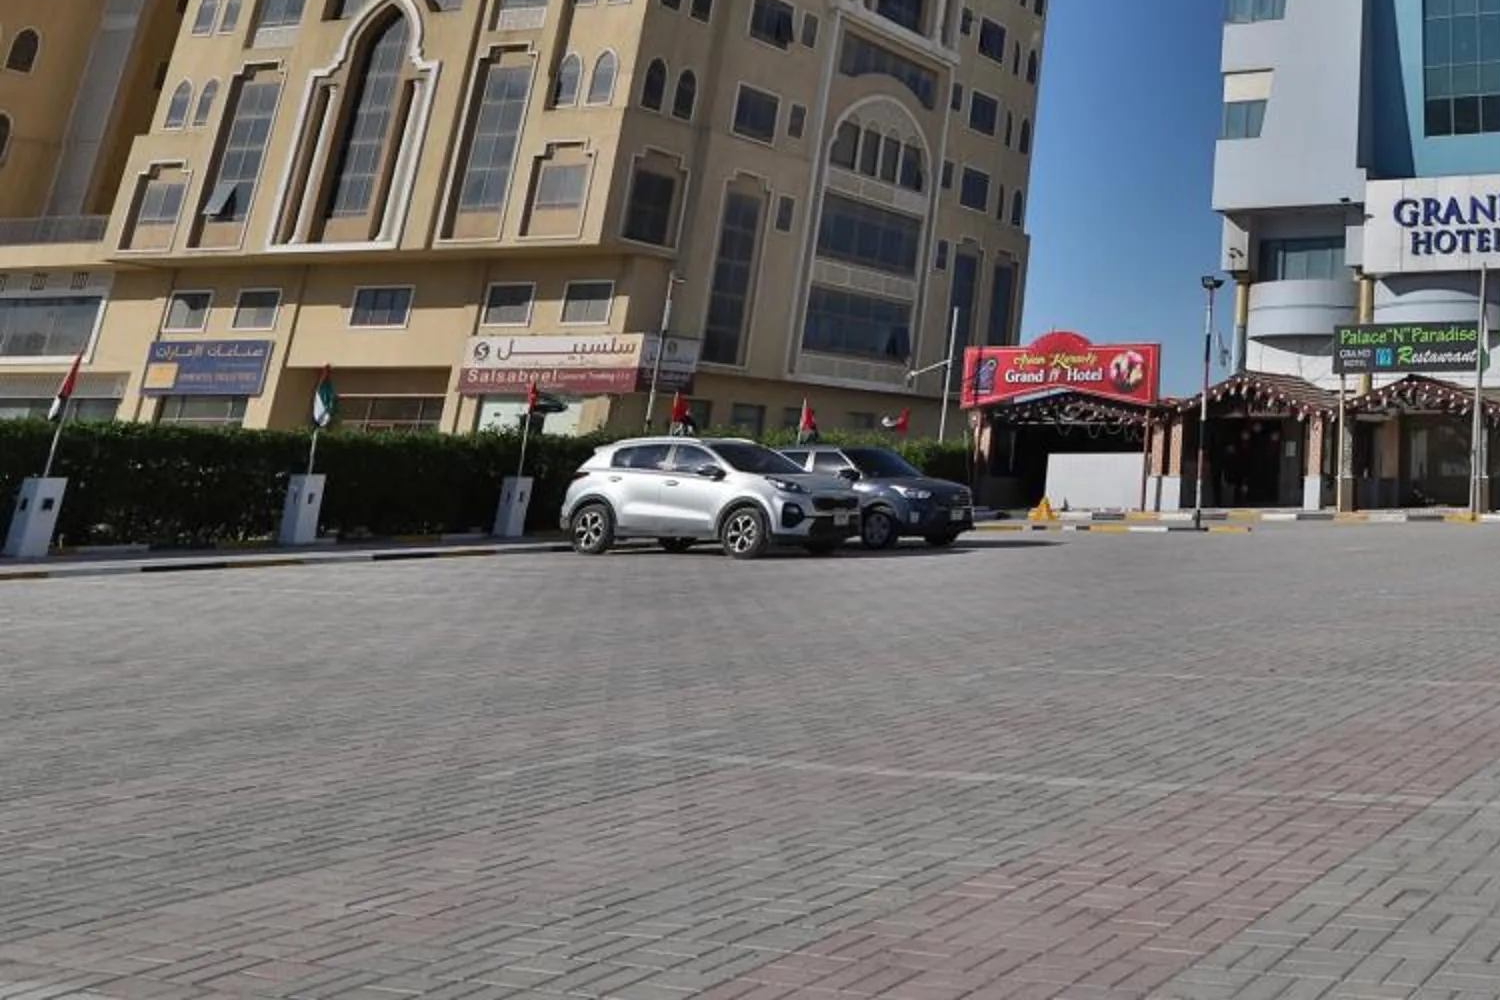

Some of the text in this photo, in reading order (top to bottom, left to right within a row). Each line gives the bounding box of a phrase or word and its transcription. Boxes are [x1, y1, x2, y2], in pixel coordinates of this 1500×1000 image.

[1397, 346, 1477, 365] Restaurant
[467, 368, 557, 384] Salsabeel
[1005, 368, 1044, 383] Grand
[1067, 367, 1103, 381] Hotel
